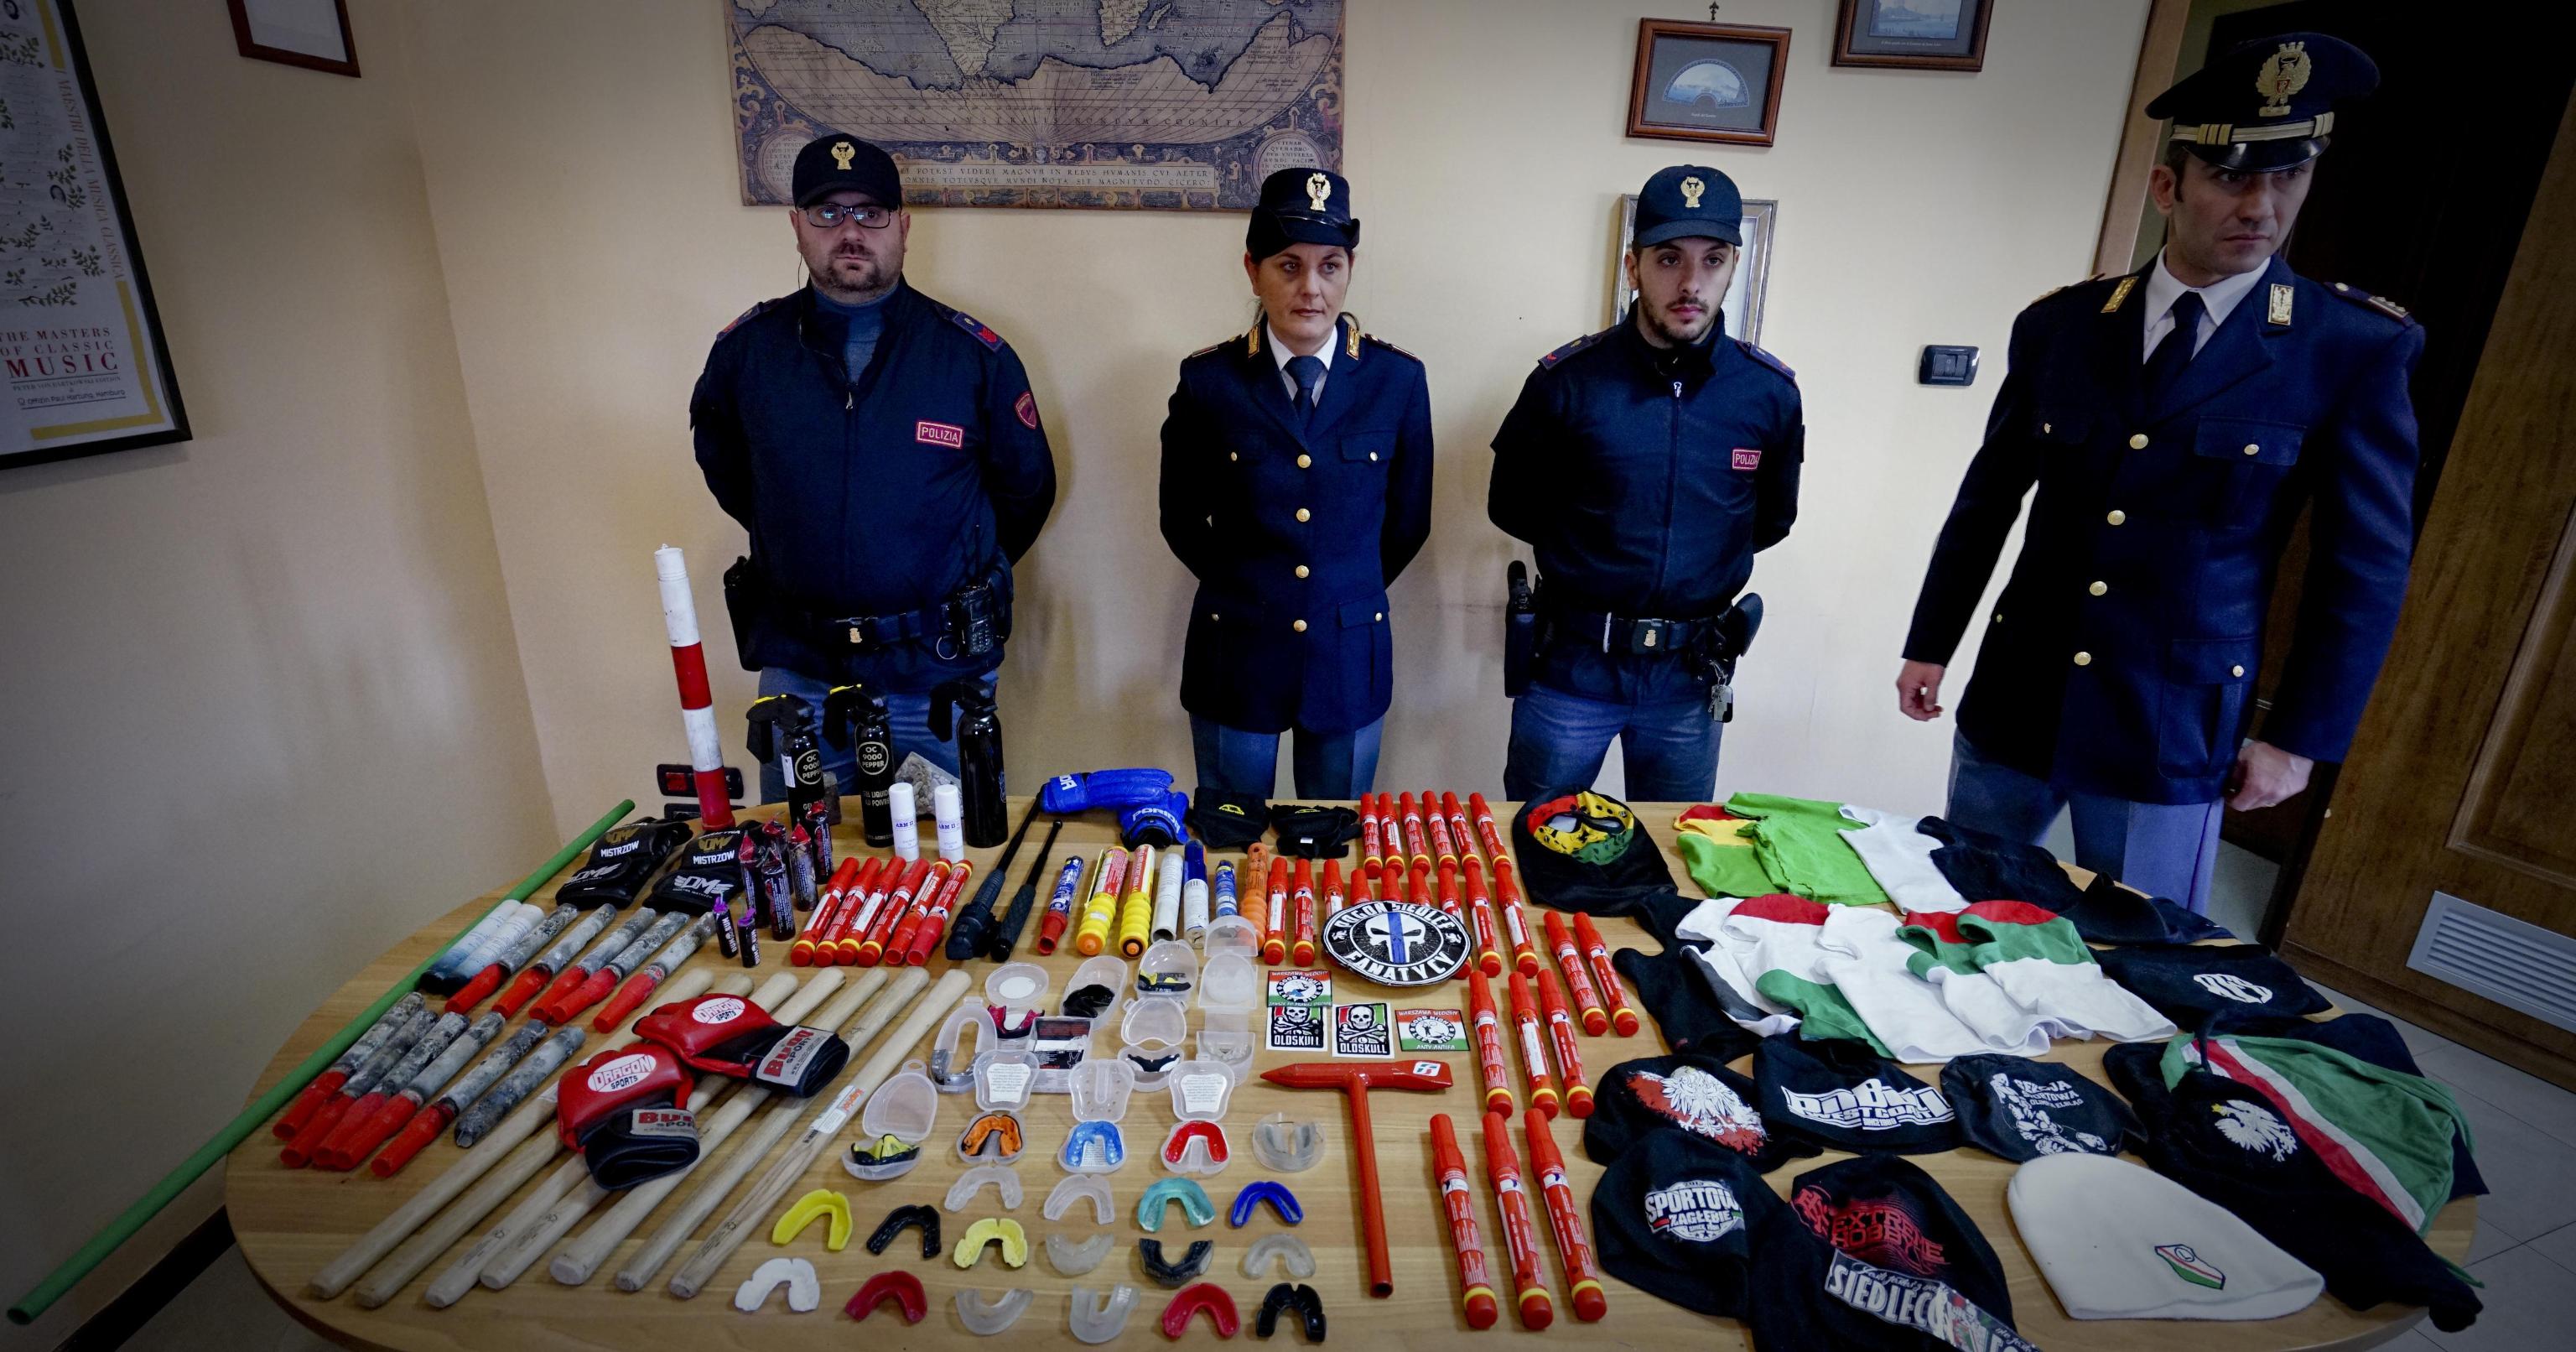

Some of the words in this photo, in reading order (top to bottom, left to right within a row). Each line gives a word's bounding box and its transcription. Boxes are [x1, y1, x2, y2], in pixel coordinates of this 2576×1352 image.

[37, 327, 111, 341] MASTERS
[0, 346, 22, 357] OF
[34, 341, 114, 354] CLASSIC
[5, 352, 118, 377] MUSIC
[921, 427, 958, 443] POLIZIA
[806, 754, 817, 762] OC
[862, 760, 885, 768] PEPPER
[1345, 949, 1456, 981] FANATYCY
[695, 998, 745, 1021] DRAGON
[715, 1009, 738, 1022] SPORTS
[786, 1036, 813, 1064] SPORT
[1340, 1043, 1388, 1053] OLDSKULL
[593, 1054, 656, 1084] DRAGON
[610, 1076, 638, 1090] SPORTS
[1832, 1208, 1945, 1265] EXTREME
